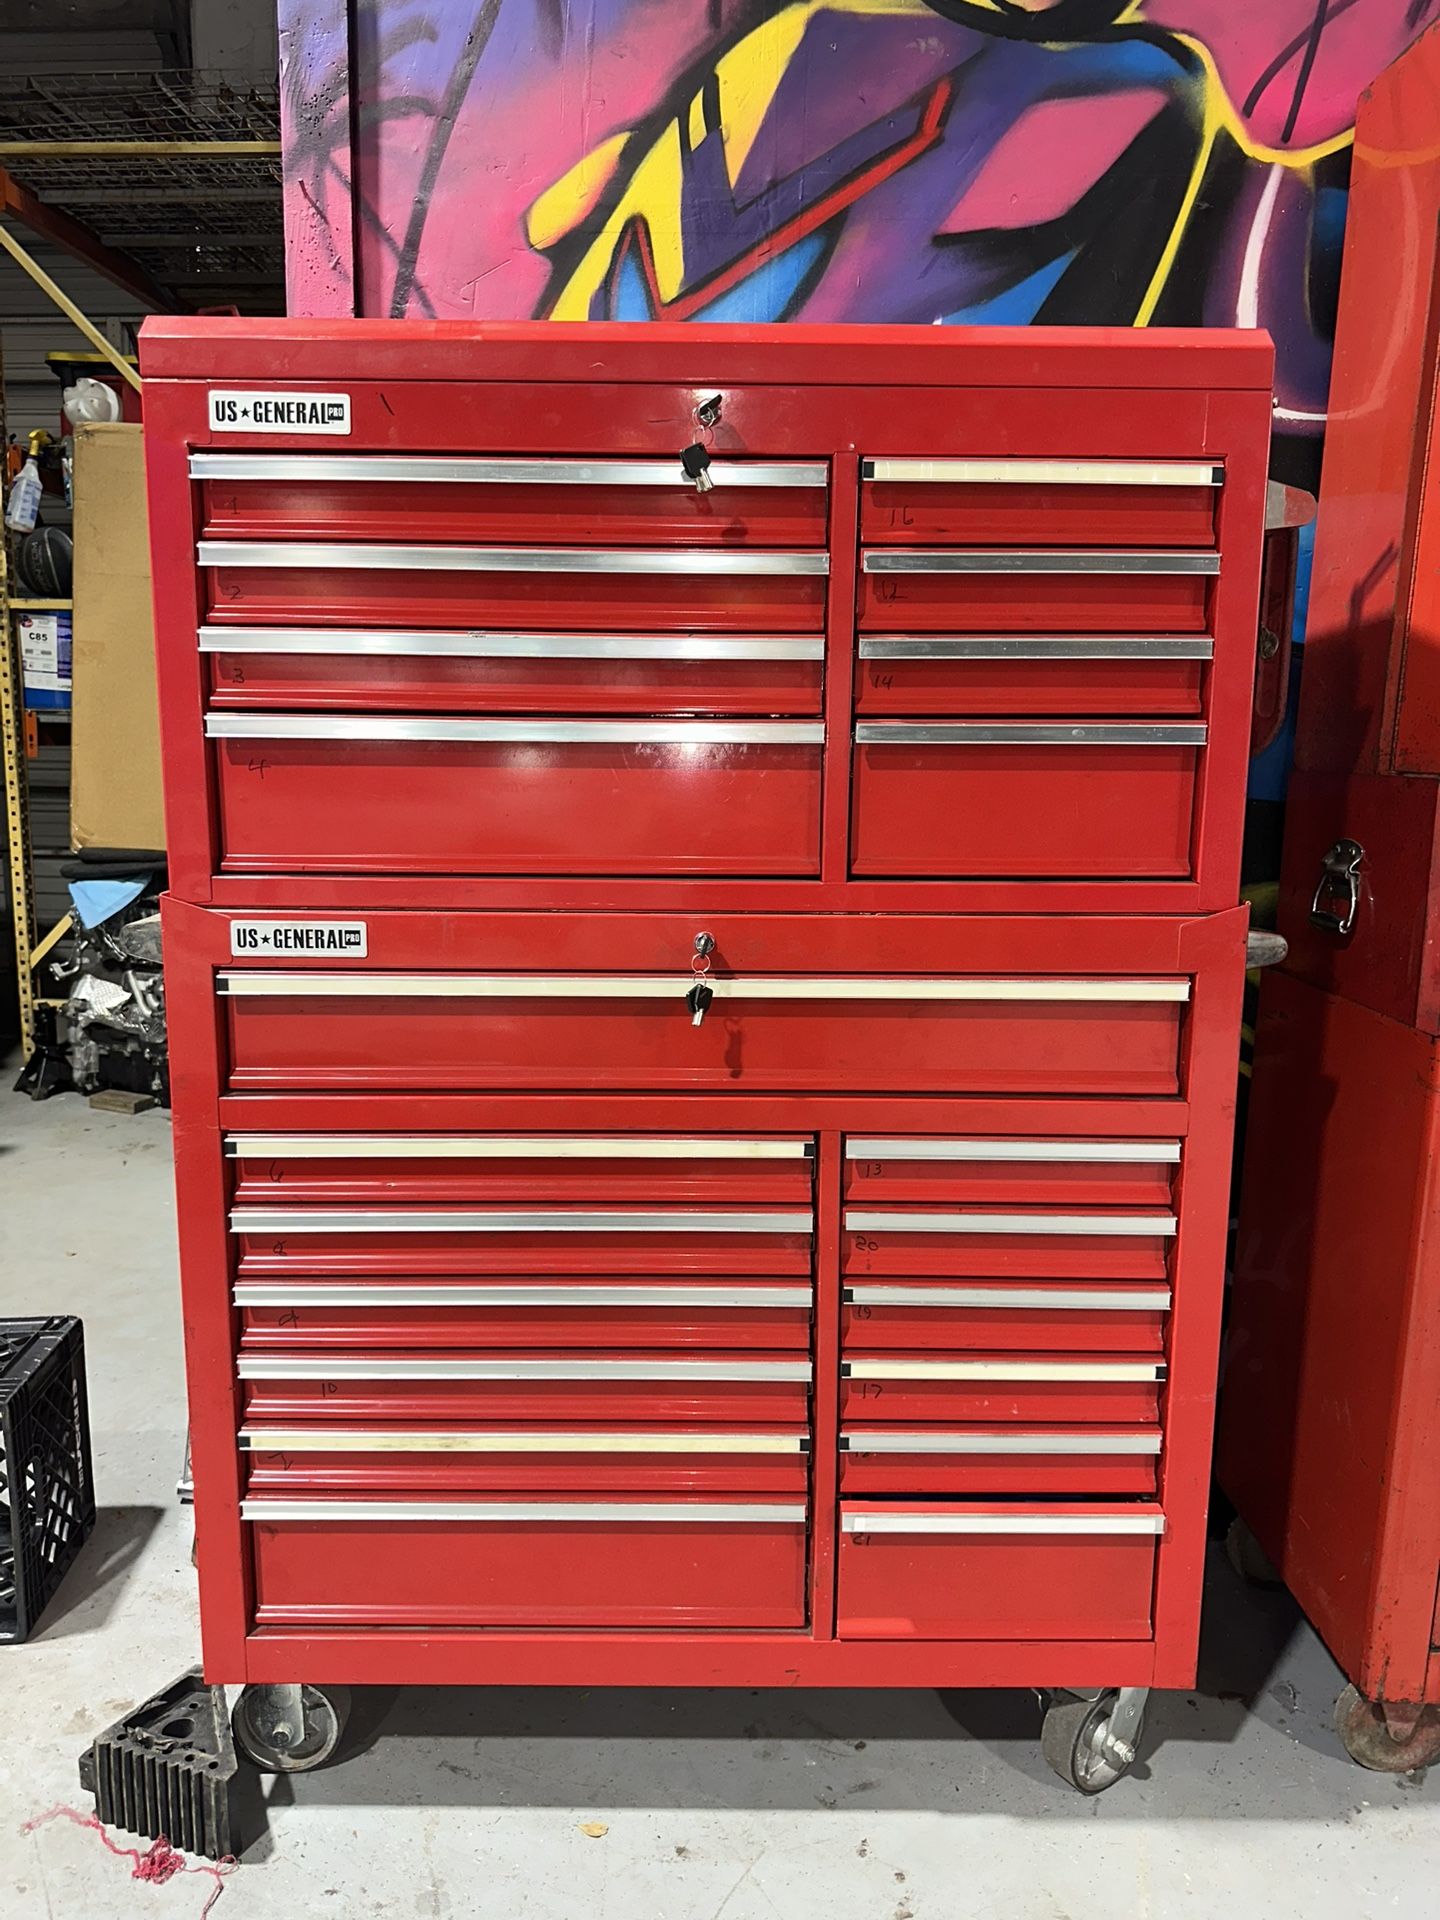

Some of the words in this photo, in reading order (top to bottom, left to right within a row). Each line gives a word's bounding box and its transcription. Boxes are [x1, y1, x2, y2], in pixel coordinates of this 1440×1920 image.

[215, 400, 238, 422] US
[253, 401, 330, 424] GENERAL
[327, 405, 343, 419] PRO
[890, 506, 914, 526] 16
[230, 585, 245, 600] 2
[28, 632, 49, 642] C85
[232, 668, 245, 684] 3
[874, 674, 894, 691] 14
[248, 758, 271, 780] 4
[236, 928, 259, 948] US
[273, 929, 348, 949] GENERAL
[345, 932, 360, 944] PRO
[269, 1160, 285, 1183] 6
[865, 1163, 882, 1178] 13
[855, 1235, 879, 1251] 20
[321, 1382, 338, 1398] 10
[861, 1382, 883, 1399] 17
